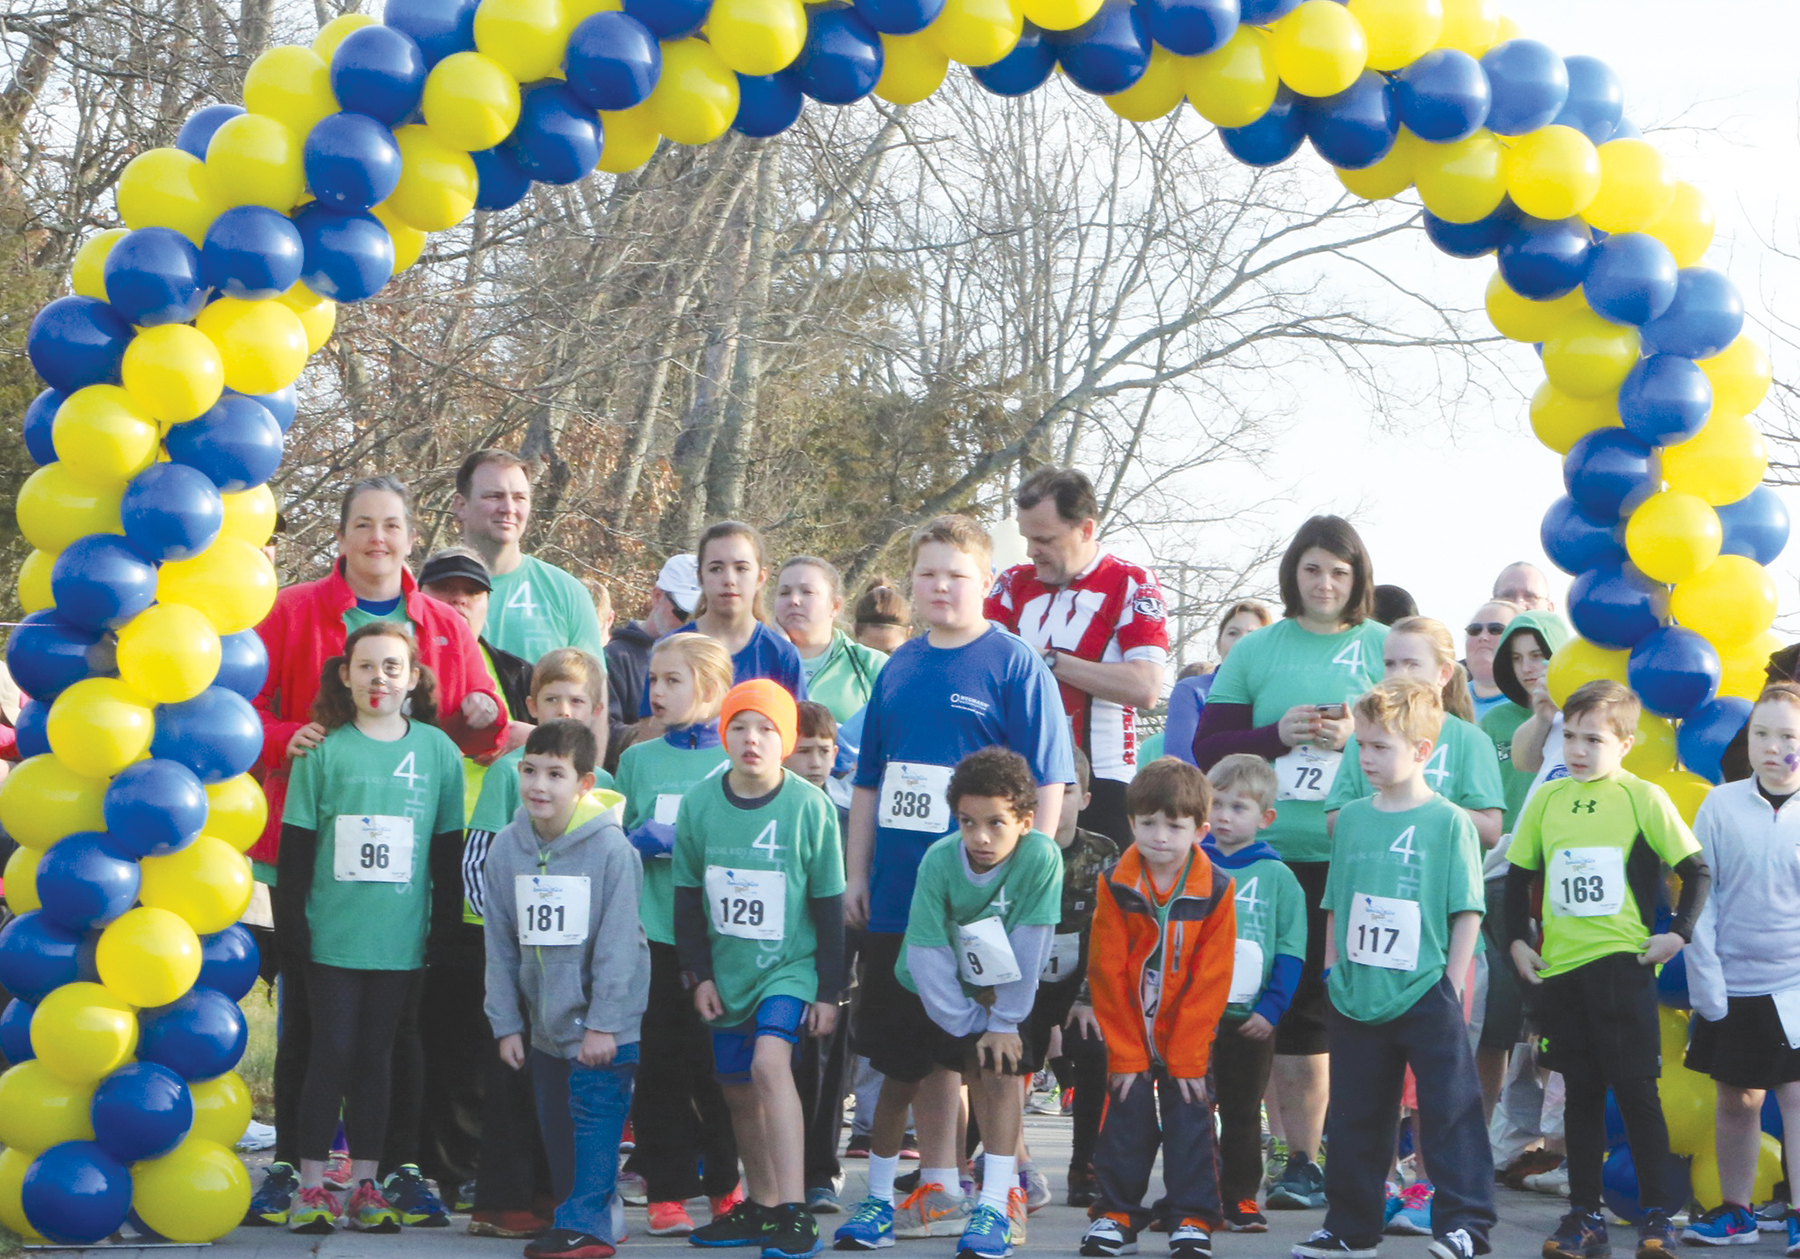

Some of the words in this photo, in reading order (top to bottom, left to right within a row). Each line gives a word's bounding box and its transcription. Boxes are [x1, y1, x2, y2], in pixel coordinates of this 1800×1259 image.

[507, 581, 538, 617] 4
[1017, 589, 1107, 652] W
[1332, 639, 1363, 674] 4
[393, 751, 420, 788] 4
[1294, 767, 1323, 791] 72
[1422, 743, 1449, 788] 4
[891, 790, 931, 819] 338
[752, 819, 780, 859] 4
[1389, 825, 1415, 864] 4
[360, 843, 390, 869] 96
[1234, 876, 1259, 911] 4
[1561, 875, 1604, 904] 163
[526, 904, 565, 932] 181
[720, 897, 764, 926] 129
[1358, 924, 1400, 954] 117
[967, 951, 984, 976] 9
